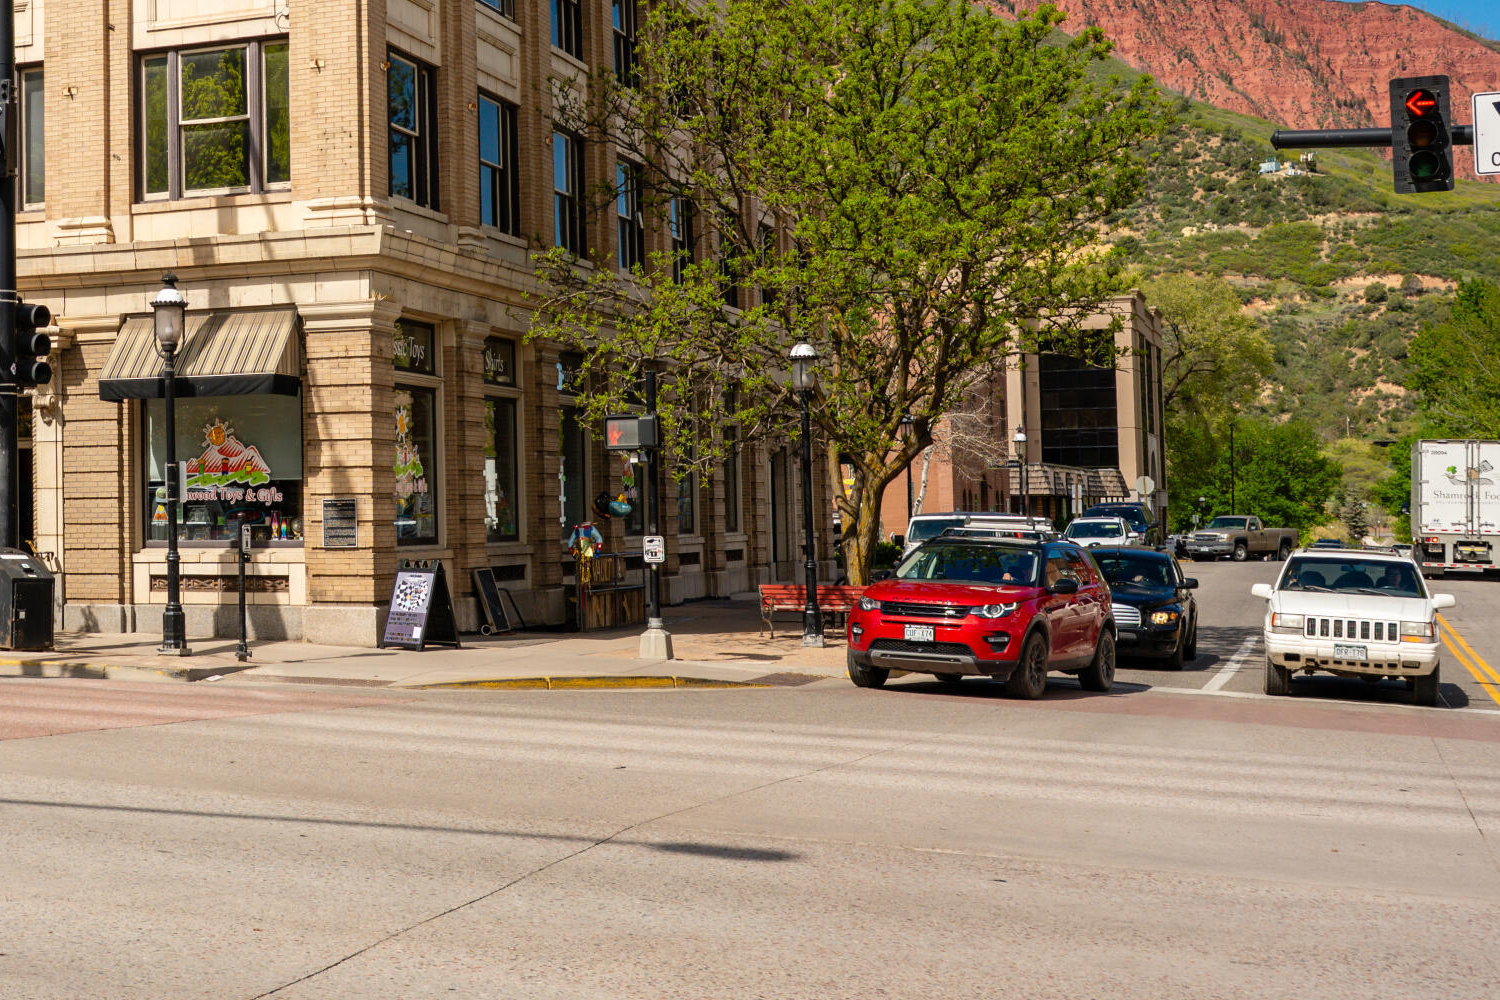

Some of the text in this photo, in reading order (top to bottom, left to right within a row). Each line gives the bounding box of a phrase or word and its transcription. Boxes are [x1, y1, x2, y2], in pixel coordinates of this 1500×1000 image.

[393, 336, 425, 367] ssic Toys
[485, 347, 504, 372] Shirts
[186, 486, 283, 506] nwood Toys & Gifts
